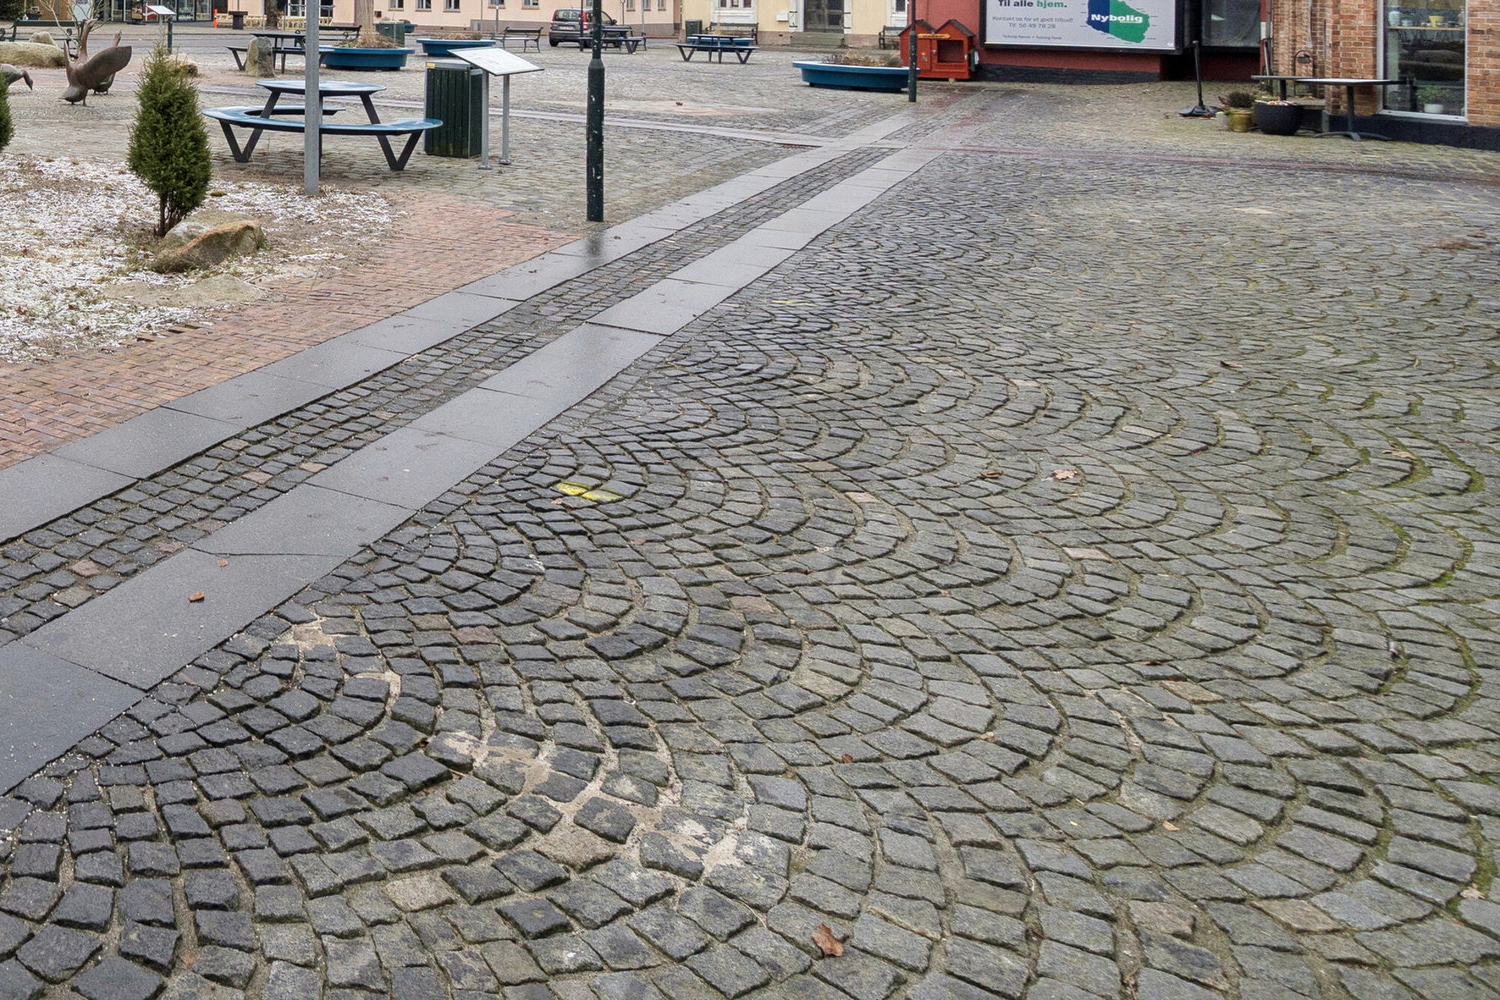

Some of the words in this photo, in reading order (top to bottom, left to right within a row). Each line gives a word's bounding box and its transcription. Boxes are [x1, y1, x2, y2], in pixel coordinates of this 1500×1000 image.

[998, 0, 1010, 7] Til
[1037, 0, 1068, 8] hjem.
[1091, 14, 1143, 23] Nybolig
